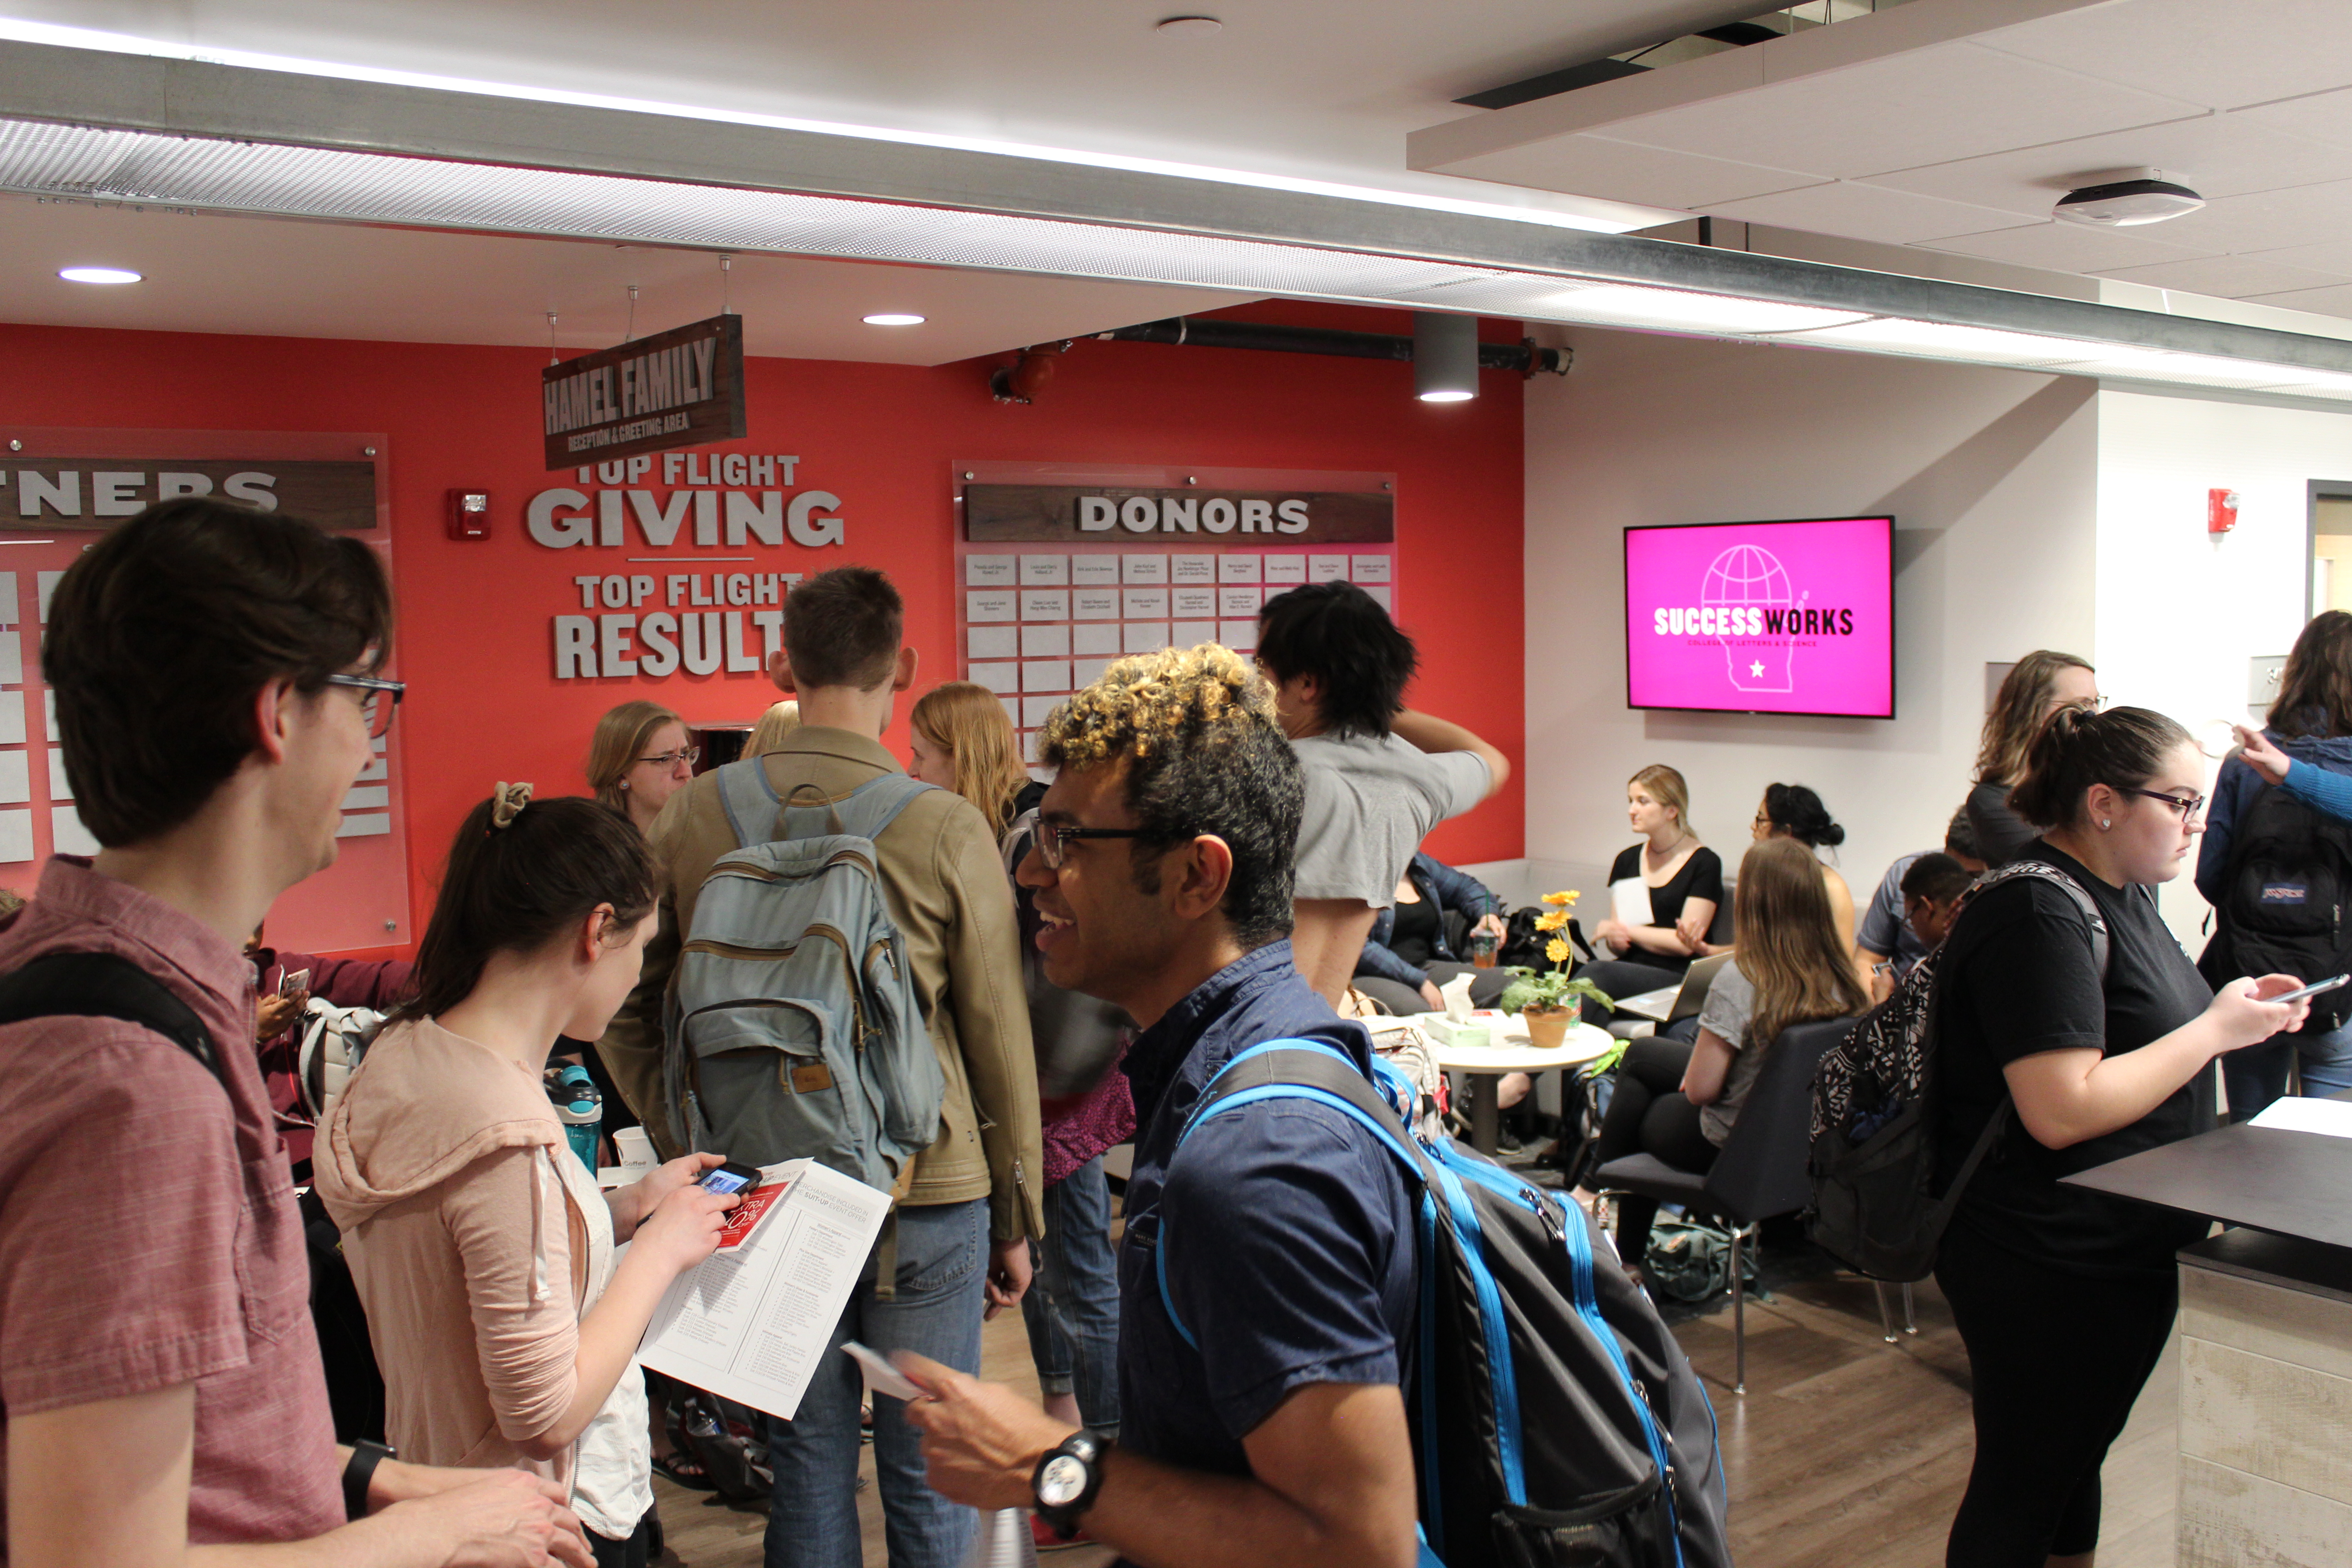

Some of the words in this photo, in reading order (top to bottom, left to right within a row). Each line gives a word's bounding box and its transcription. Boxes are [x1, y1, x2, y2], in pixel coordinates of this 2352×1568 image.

[545, 366, 621, 435] HAMEL
[622, 337, 716, 417] FAMILY
[568, 428, 612, 452] RECEPTION
[612, 427, 618, 444] &
[619, 417, 663, 443] GREETING
[664, 411, 690, 434] AREA
[663, 453, 799, 486] FLIGHT
[0, 470, 279, 516] NERS
[527, 488, 844, 548] GIVING
[1079, 496, 1309, 534] DONORS
[575, 575, 655, 608] TOP
[667, 573, 803, 606] FLIGHT
[774, 1171, 798, 1181] EVENT
[730, 1199, 766, 1213] XTRA
[791, 1186, 804, 1195] THE
[804, 1191, 829, 1206] SUIT-UP
[828, 1203, 848, 1215] EVENT
[848, 1211, 867, 1223] OFFER
[794, 1181, 837, 1203] MERCHANDISE
[836, 1198, 862, 1214] INCLUDED
